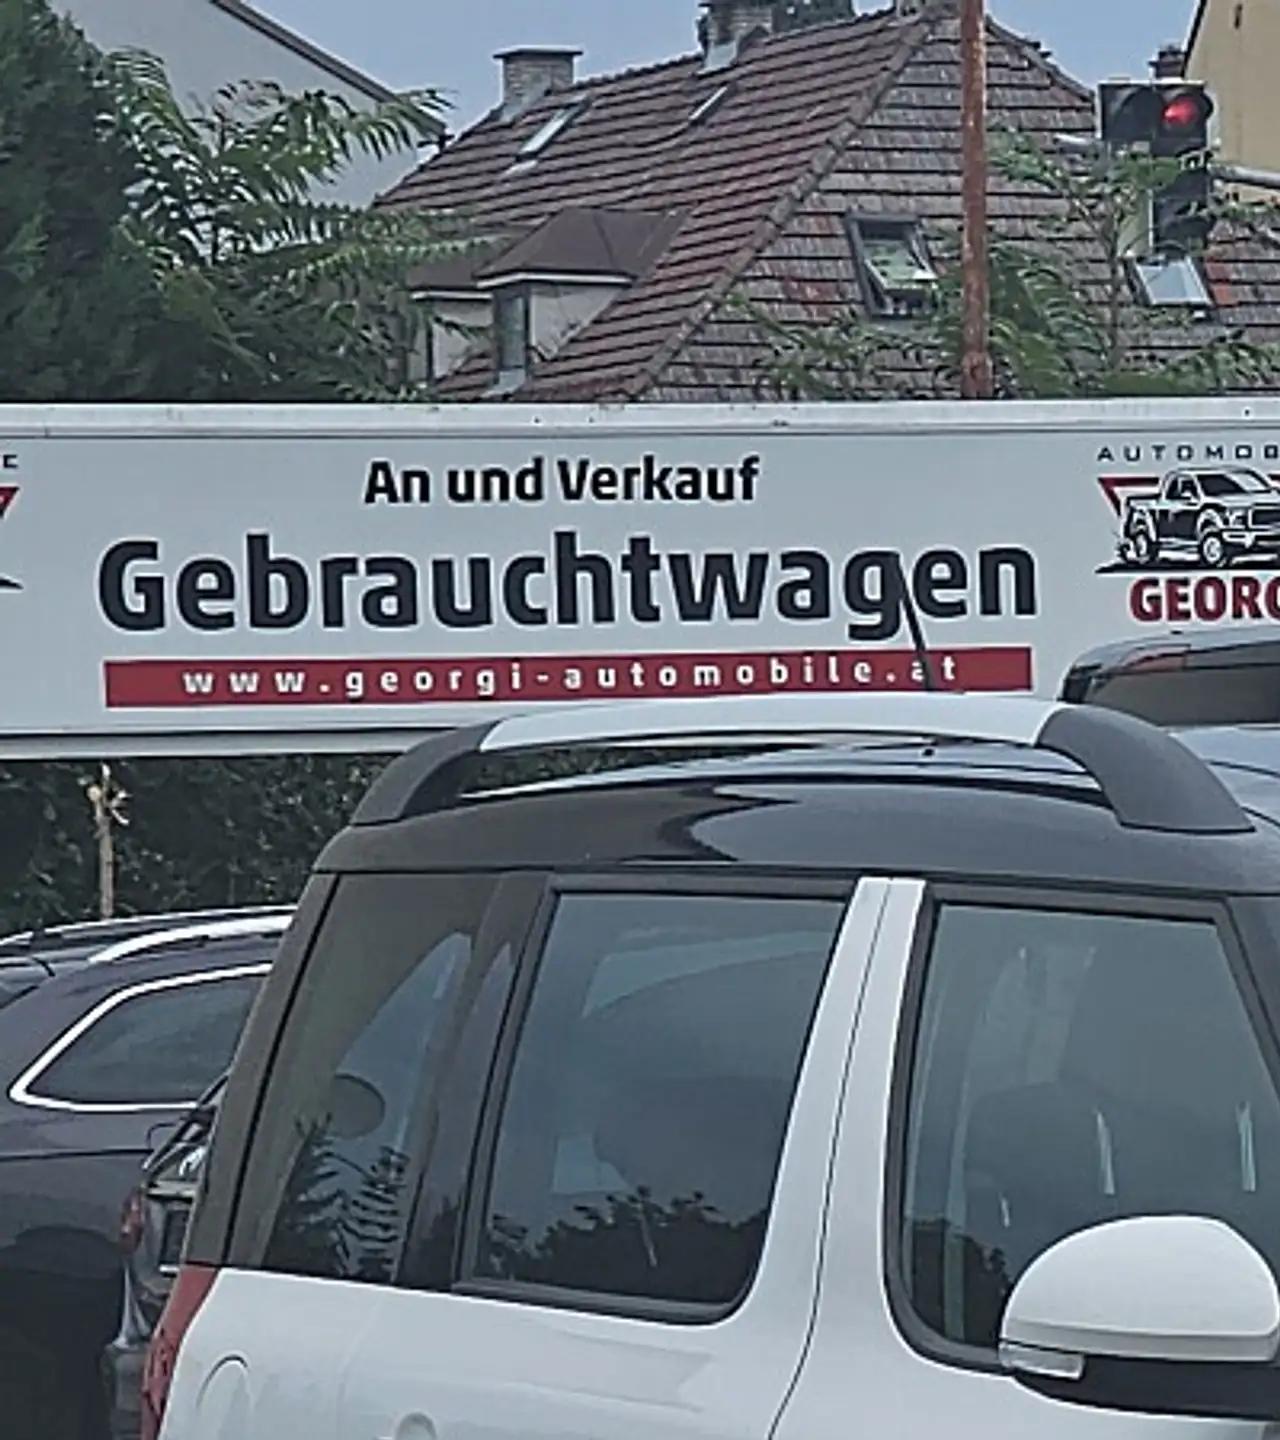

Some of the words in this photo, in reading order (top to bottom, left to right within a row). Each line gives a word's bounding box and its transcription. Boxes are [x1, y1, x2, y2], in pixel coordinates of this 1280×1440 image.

[363, 460, 431, 504] An
[447, 456, 545, 503] und
[556, 454, 761, 502] Verkauf
[98, 529, 1037, 642] Gebrauchtwagen
[181, 654, 956, 699] www.georgi-automobile.at
